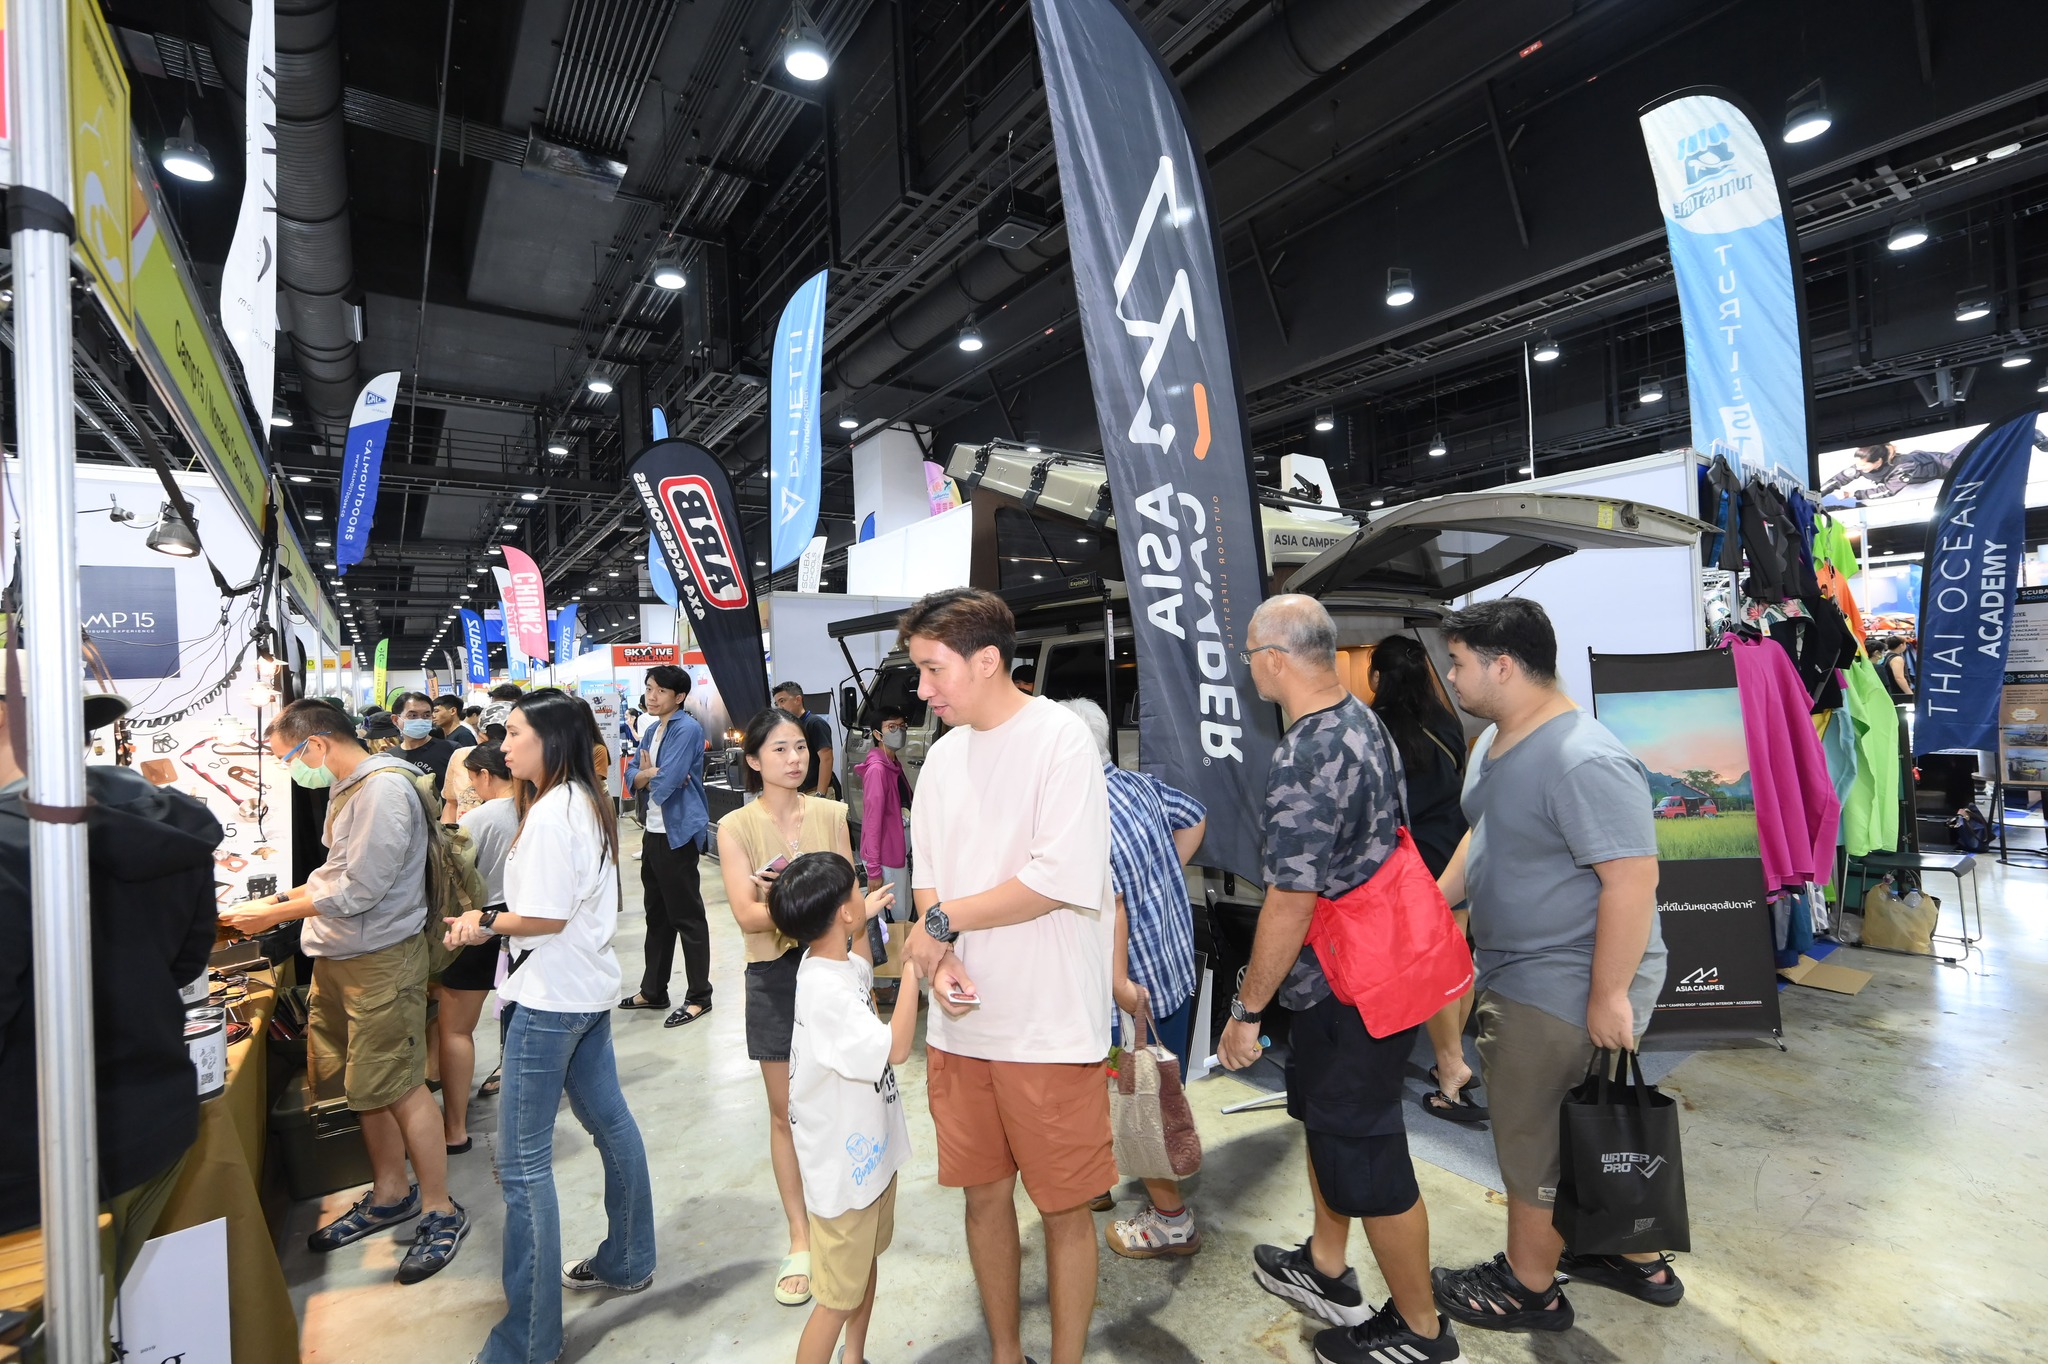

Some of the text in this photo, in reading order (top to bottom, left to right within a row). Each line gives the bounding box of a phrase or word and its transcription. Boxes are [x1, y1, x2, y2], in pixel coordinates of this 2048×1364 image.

[344, 439, 373, 541] CALMOUTDOORS
[801, 551, 811, 589] SCUBA
[1274, 534, 1299, 546] ASIA
[132, 612, 155, 628] 15
[1928, 480, 1985, 717] THAI OCEAN
[1977, 539, 2008, 659] ACADEMY
